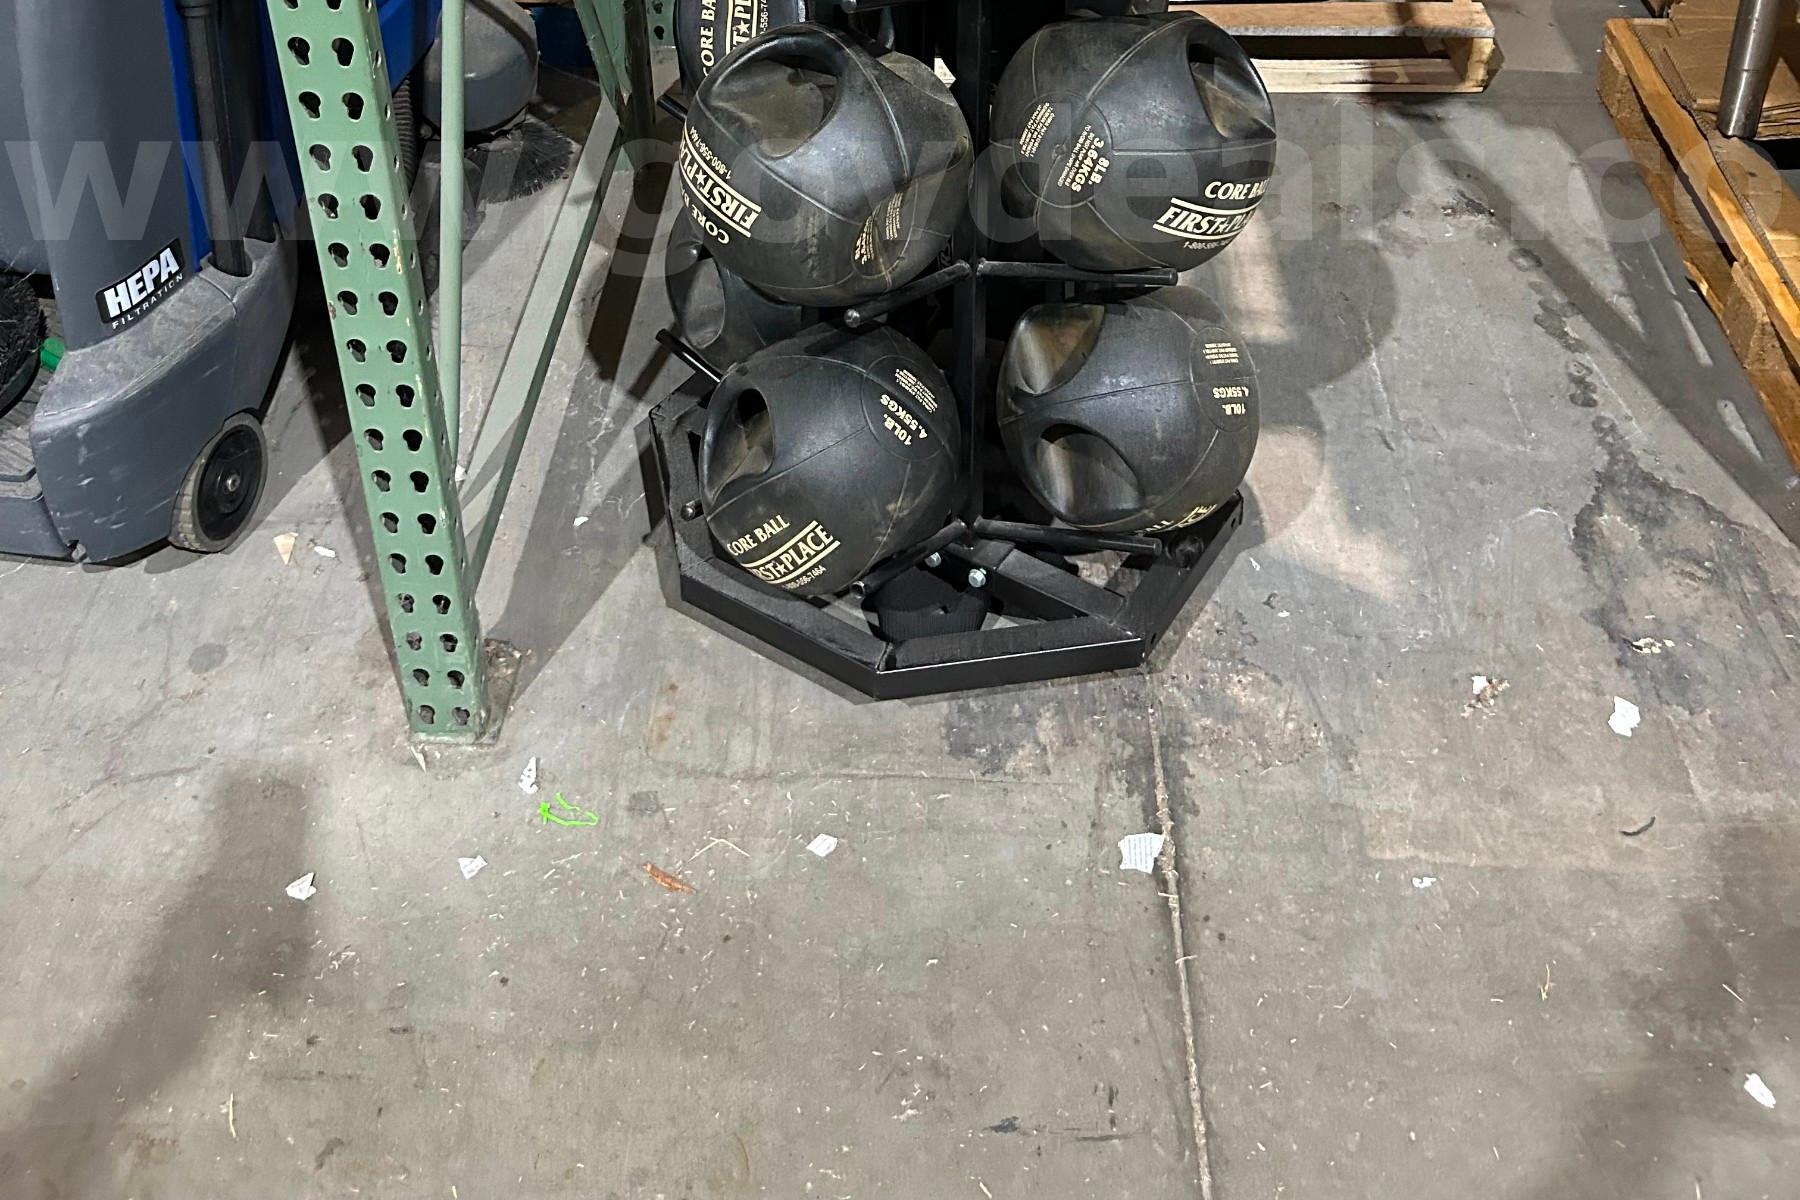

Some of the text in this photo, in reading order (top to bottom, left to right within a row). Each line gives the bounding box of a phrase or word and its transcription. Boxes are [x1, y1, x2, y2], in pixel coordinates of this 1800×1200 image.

[1071, 137, 1105, 192] 3.64KGS
[697, 177, 760, 230] FIRST
[1204, 181, 1252, 200] CORE
[691, 203, 730, 244] CORE
[1156, 206, 1227, 235] FIRST
[103, 247, 180, 319] HEPA
[111, 273, 184, 330] FILTRATION
[1212, 386, 1249, 399] 4.55KGS
[880, 394, 928, 439] 4.55KGS
[883, 413, 912, 446] 10LB.
[726, 514, 790, 556] CORE BALL
[780, 524, 834, 571] PLACE
